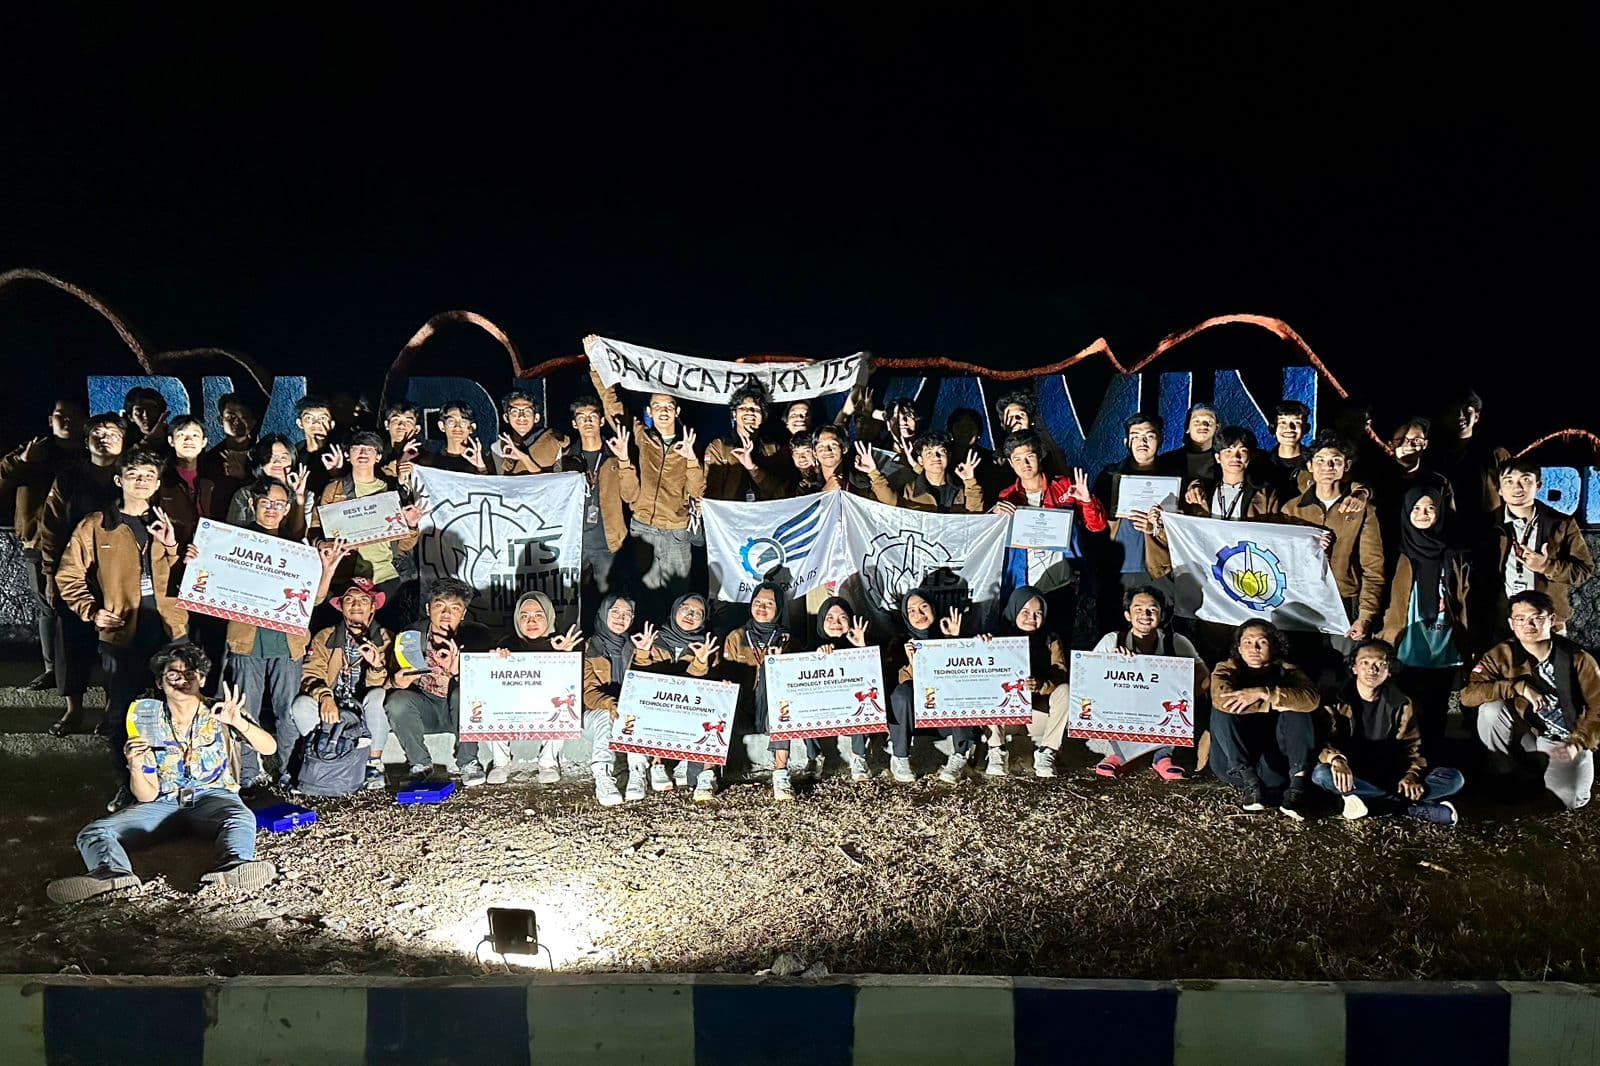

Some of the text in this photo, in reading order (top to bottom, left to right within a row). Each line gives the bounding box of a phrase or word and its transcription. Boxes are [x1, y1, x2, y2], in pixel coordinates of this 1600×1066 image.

[820, 355, 860, 388] ITS
[343, 506, 361, 516] BEST
[229, 546, 288, 569] JUARA 3
[214, 553, 254, 568] TECHNOLOGY
[255, 563, 300, 580] DEVELOPMENT
[945, 656, 995, 667] JUARA 3
[490, 670, 542, 679] HARAPAN
[797, 667, 845, 680] JUARA 1
[1103, 670, 1160, 683] JUARA 2
[786, 680, 821, 689] TECHNOLOGY
[823, 677, 864, 686] DEVELOPMENT
[653, 691, 702, 705] JUARA 3
[639, 699, 674, 710] TECHNOLOGY
[675, 704, 716, 714] DEVELOPMENT
